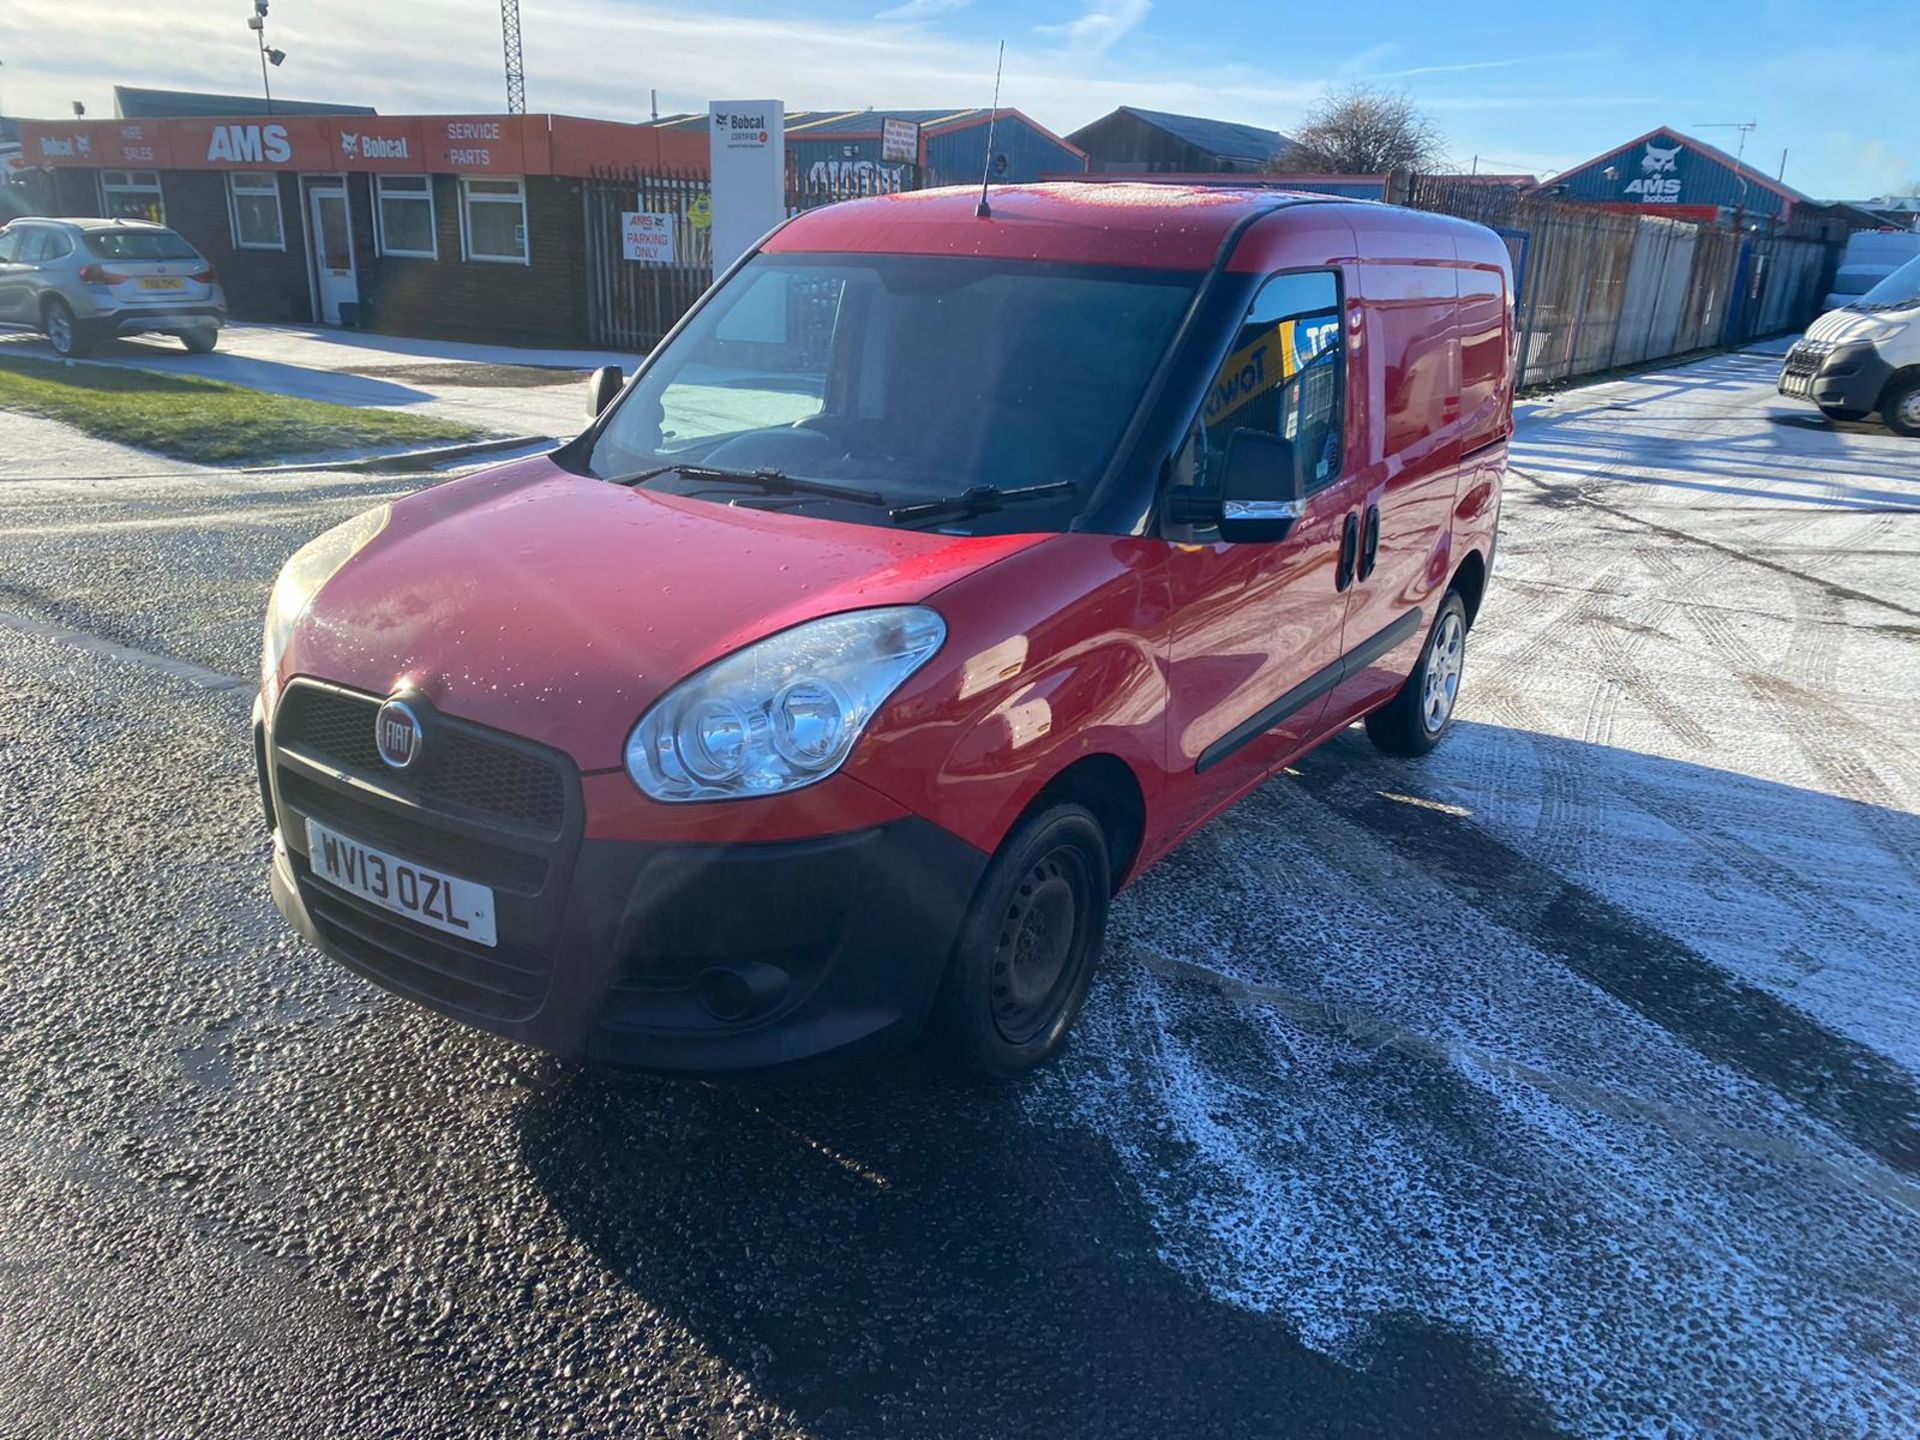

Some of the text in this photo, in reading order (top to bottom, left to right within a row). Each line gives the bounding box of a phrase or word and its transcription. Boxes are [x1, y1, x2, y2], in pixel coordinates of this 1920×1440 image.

[731, 114, 765, 129] Bobcat
[448, 123, 500, 140] SERVICE
[207, 125, 292, 163] AMS
[362, 136, 409, 158] Bobcat
[451, 149, 490, 166] PARTS
[1623, 179, 1681, 193] AMS
[631, 215, 653, 226] AMS
[627, 233, 668, 246] PARKING
[635, 246, 658, 258] ONLY
[385, 720, 411, 754] FIAT
[322, 833, 469, 930] WV13 OZL
